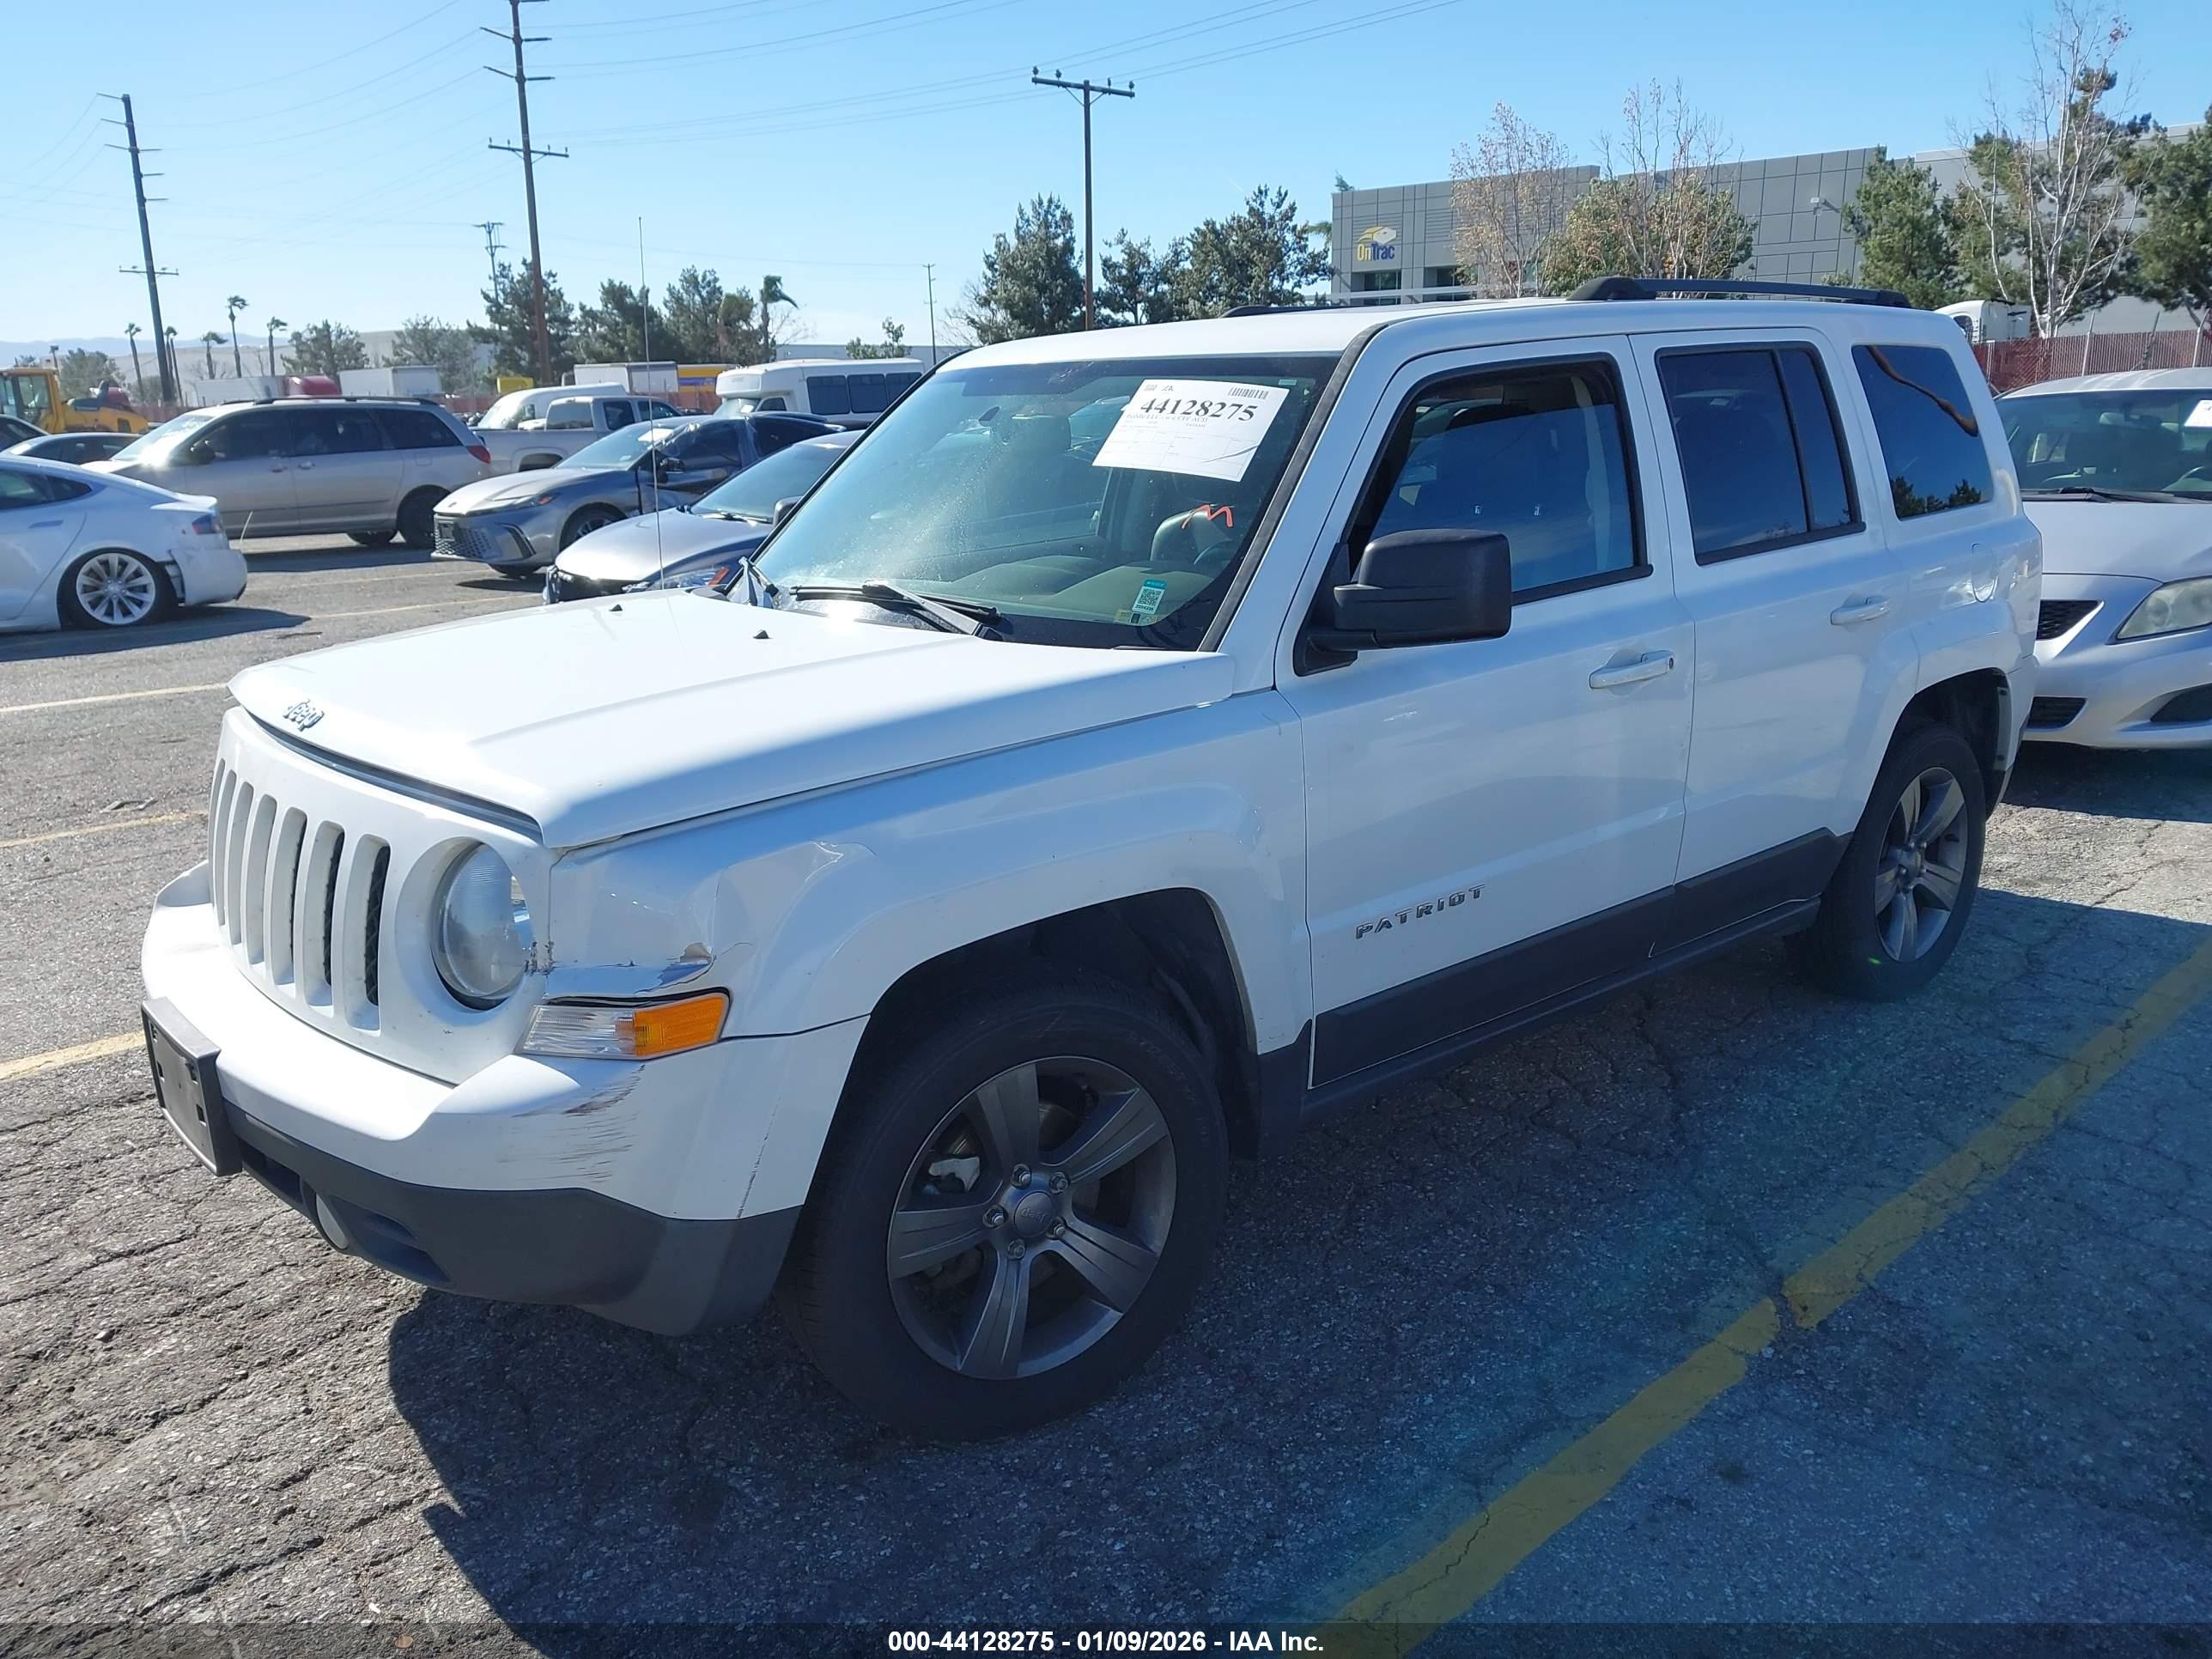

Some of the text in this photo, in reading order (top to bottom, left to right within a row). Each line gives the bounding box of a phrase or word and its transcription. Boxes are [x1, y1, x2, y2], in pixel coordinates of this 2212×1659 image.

[1357, 240, 1395, 261] OnTrac
[1140, 398, 1258, 422] 44128275
[1355, 884, 1486, 939] PATRIOT
